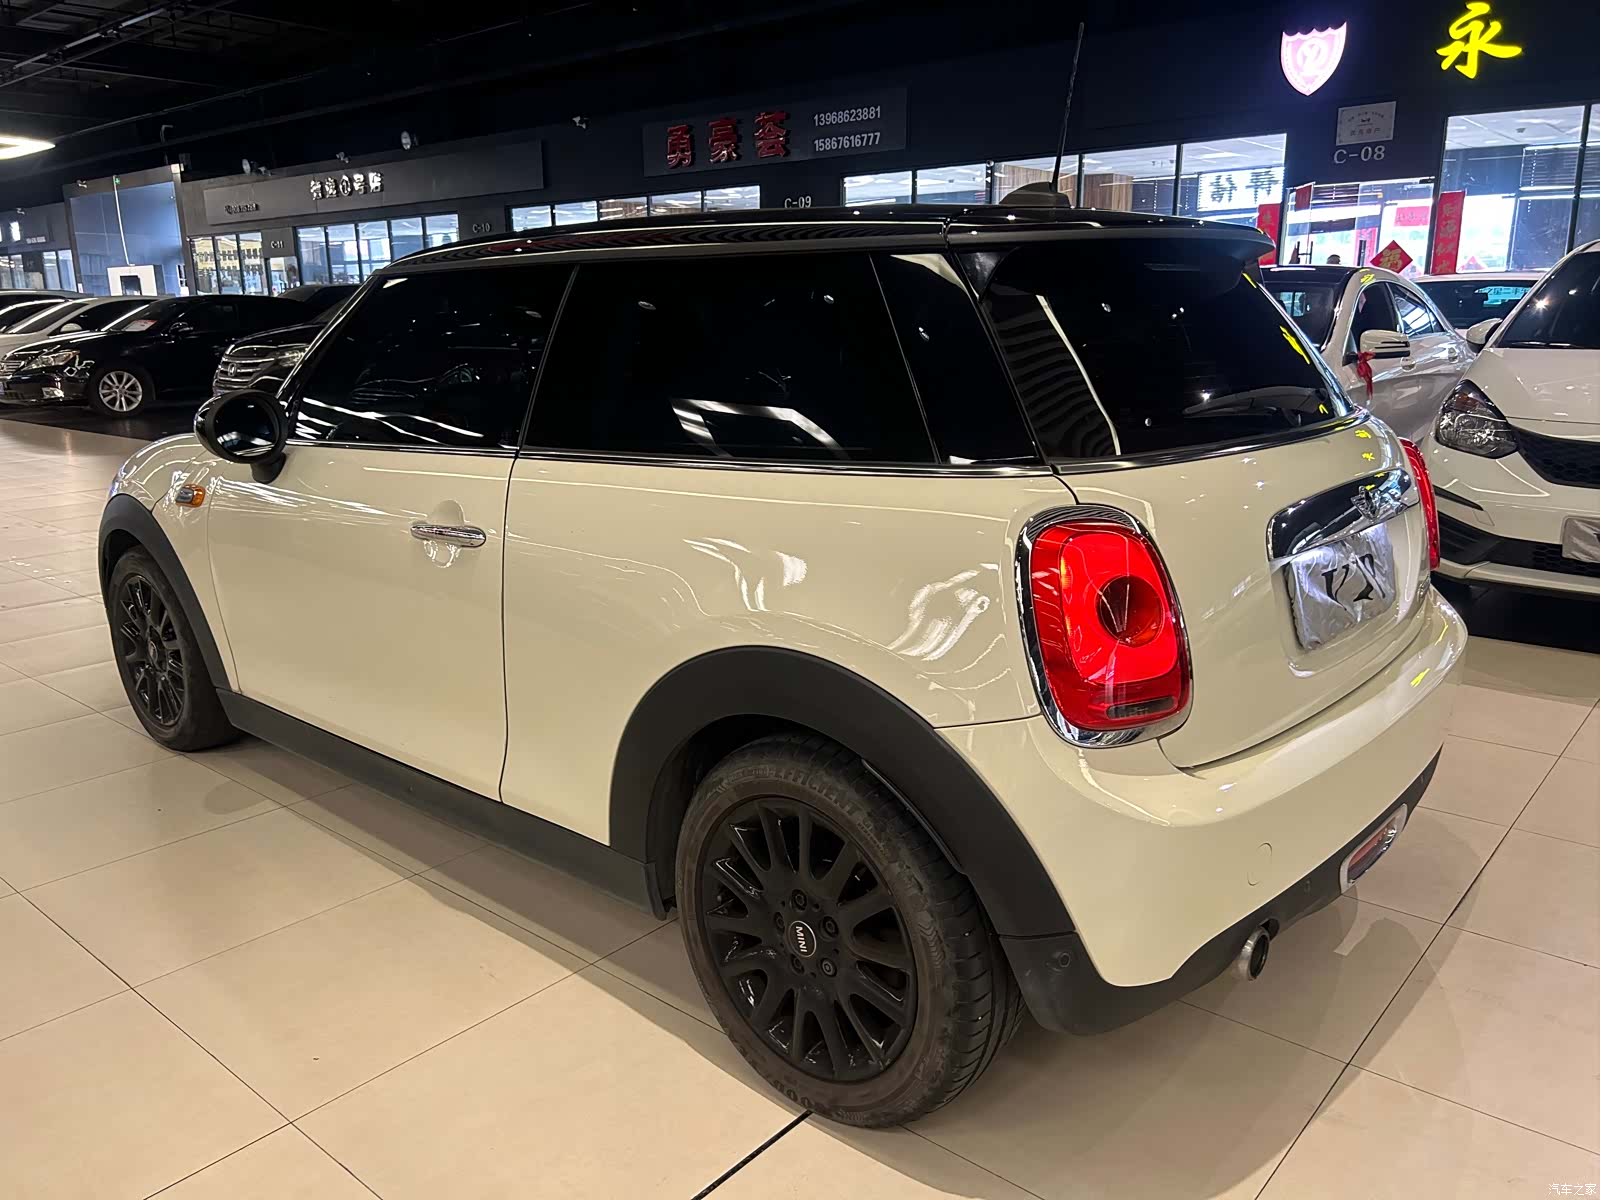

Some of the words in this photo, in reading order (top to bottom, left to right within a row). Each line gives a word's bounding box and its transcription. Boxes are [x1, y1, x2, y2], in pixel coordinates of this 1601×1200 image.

[1436, 1, 1522, 79] 永
[813, 105, 881, 126] 13968623881
[813, 131, 881, 152] 15867616777
[1333, 145, 1386, 164] C-08
[784, 194, 812, 209] C-09
[472, 222, 491, 233] C-10
[270, 240, 284, 249] C-11
[794, 926, 808, 953] MINI
